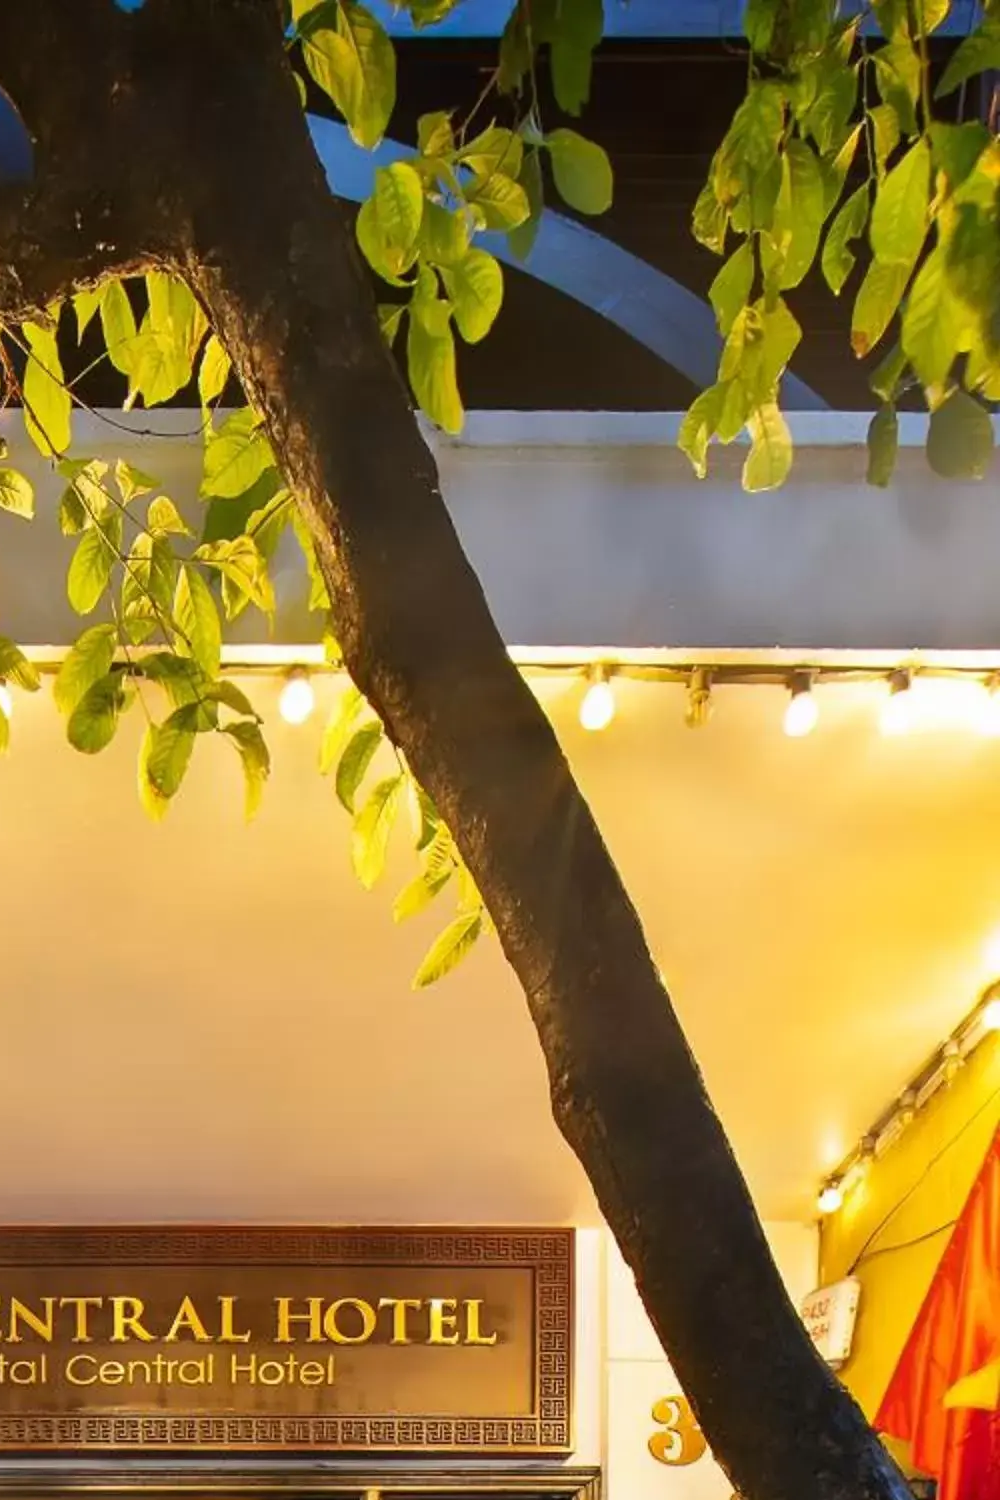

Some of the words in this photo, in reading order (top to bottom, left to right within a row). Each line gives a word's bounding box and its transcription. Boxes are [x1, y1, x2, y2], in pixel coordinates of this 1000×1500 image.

[273, 1296, 498, 1344] HOTEL
[66, 1352, 214, 1385] Central
[230, 1353, 335, 1386] Hotel
